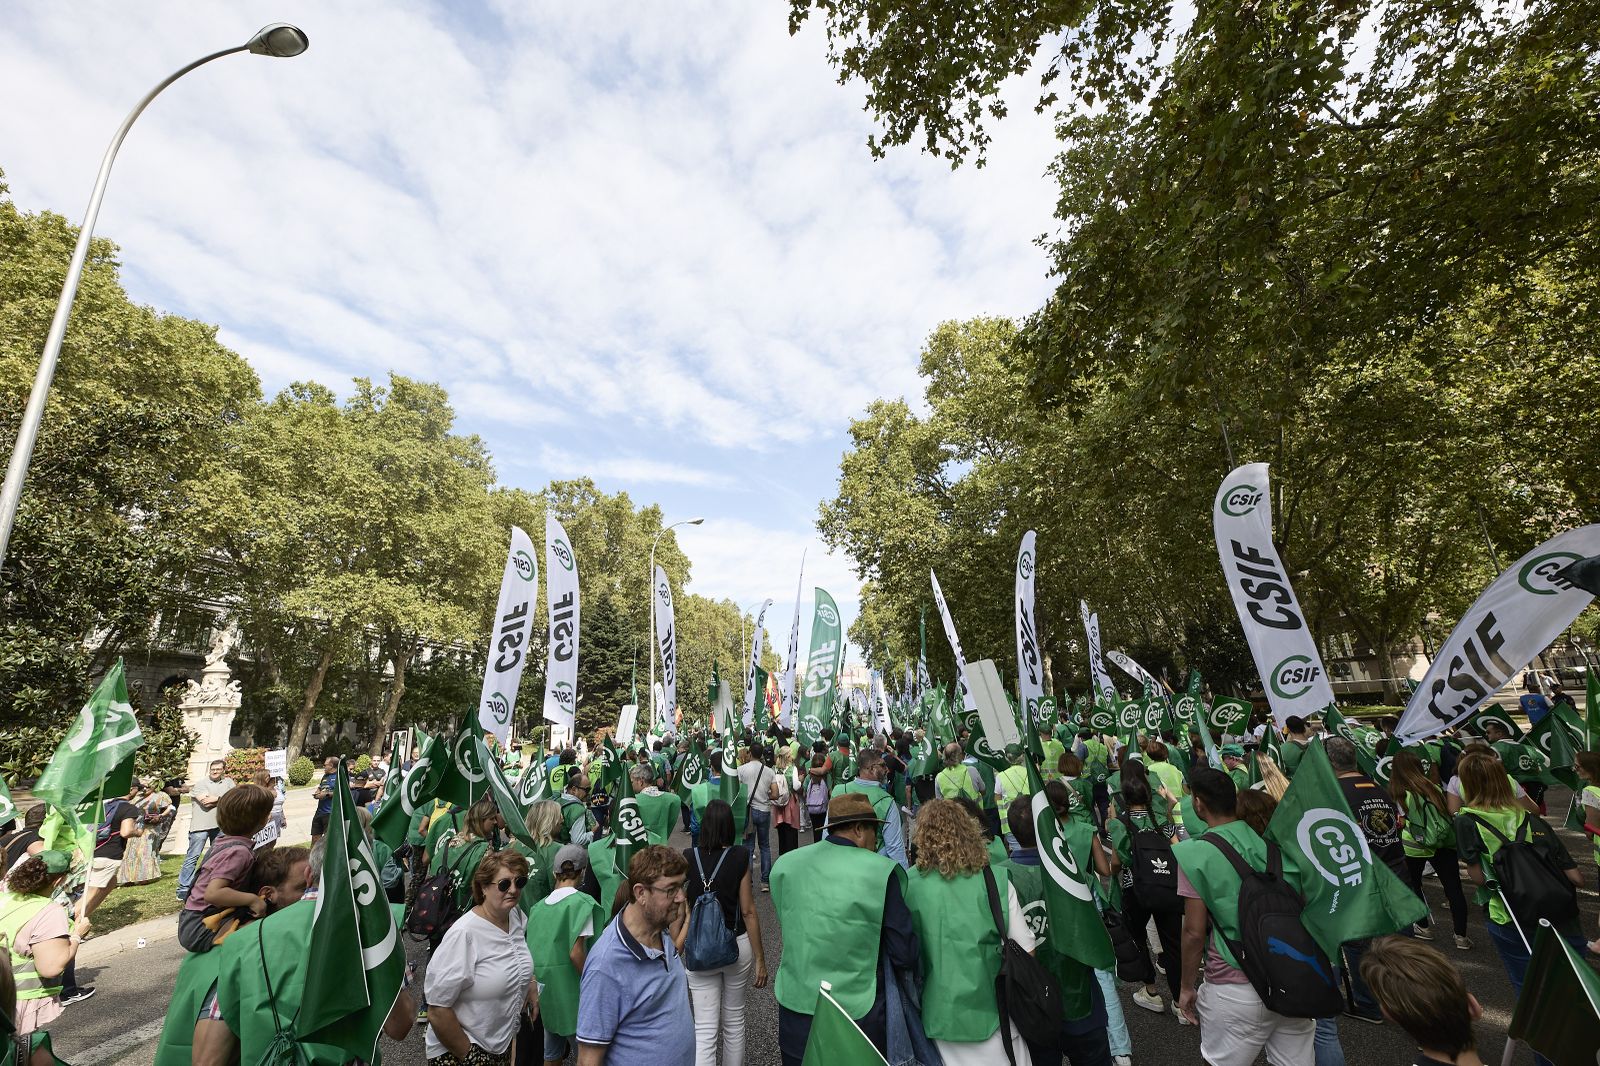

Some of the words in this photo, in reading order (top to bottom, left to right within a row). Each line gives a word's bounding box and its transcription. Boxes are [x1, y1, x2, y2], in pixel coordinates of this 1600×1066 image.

[1229, 492, 1263, 506] CSIF
[1230, 539, 1303, 631] CSIF
[1279, 666, 1321, 687] CSIF
[1427, 610, 1516, 726] CSIF
[1218, 708, 1246, 722] CSIF
[525, 762, 547, 795] CSIF
[684, 754, 701, 781] CSIF
[618, 807, 648, 842] CSIF
[1315, 826, 1362, 887] CSIF
